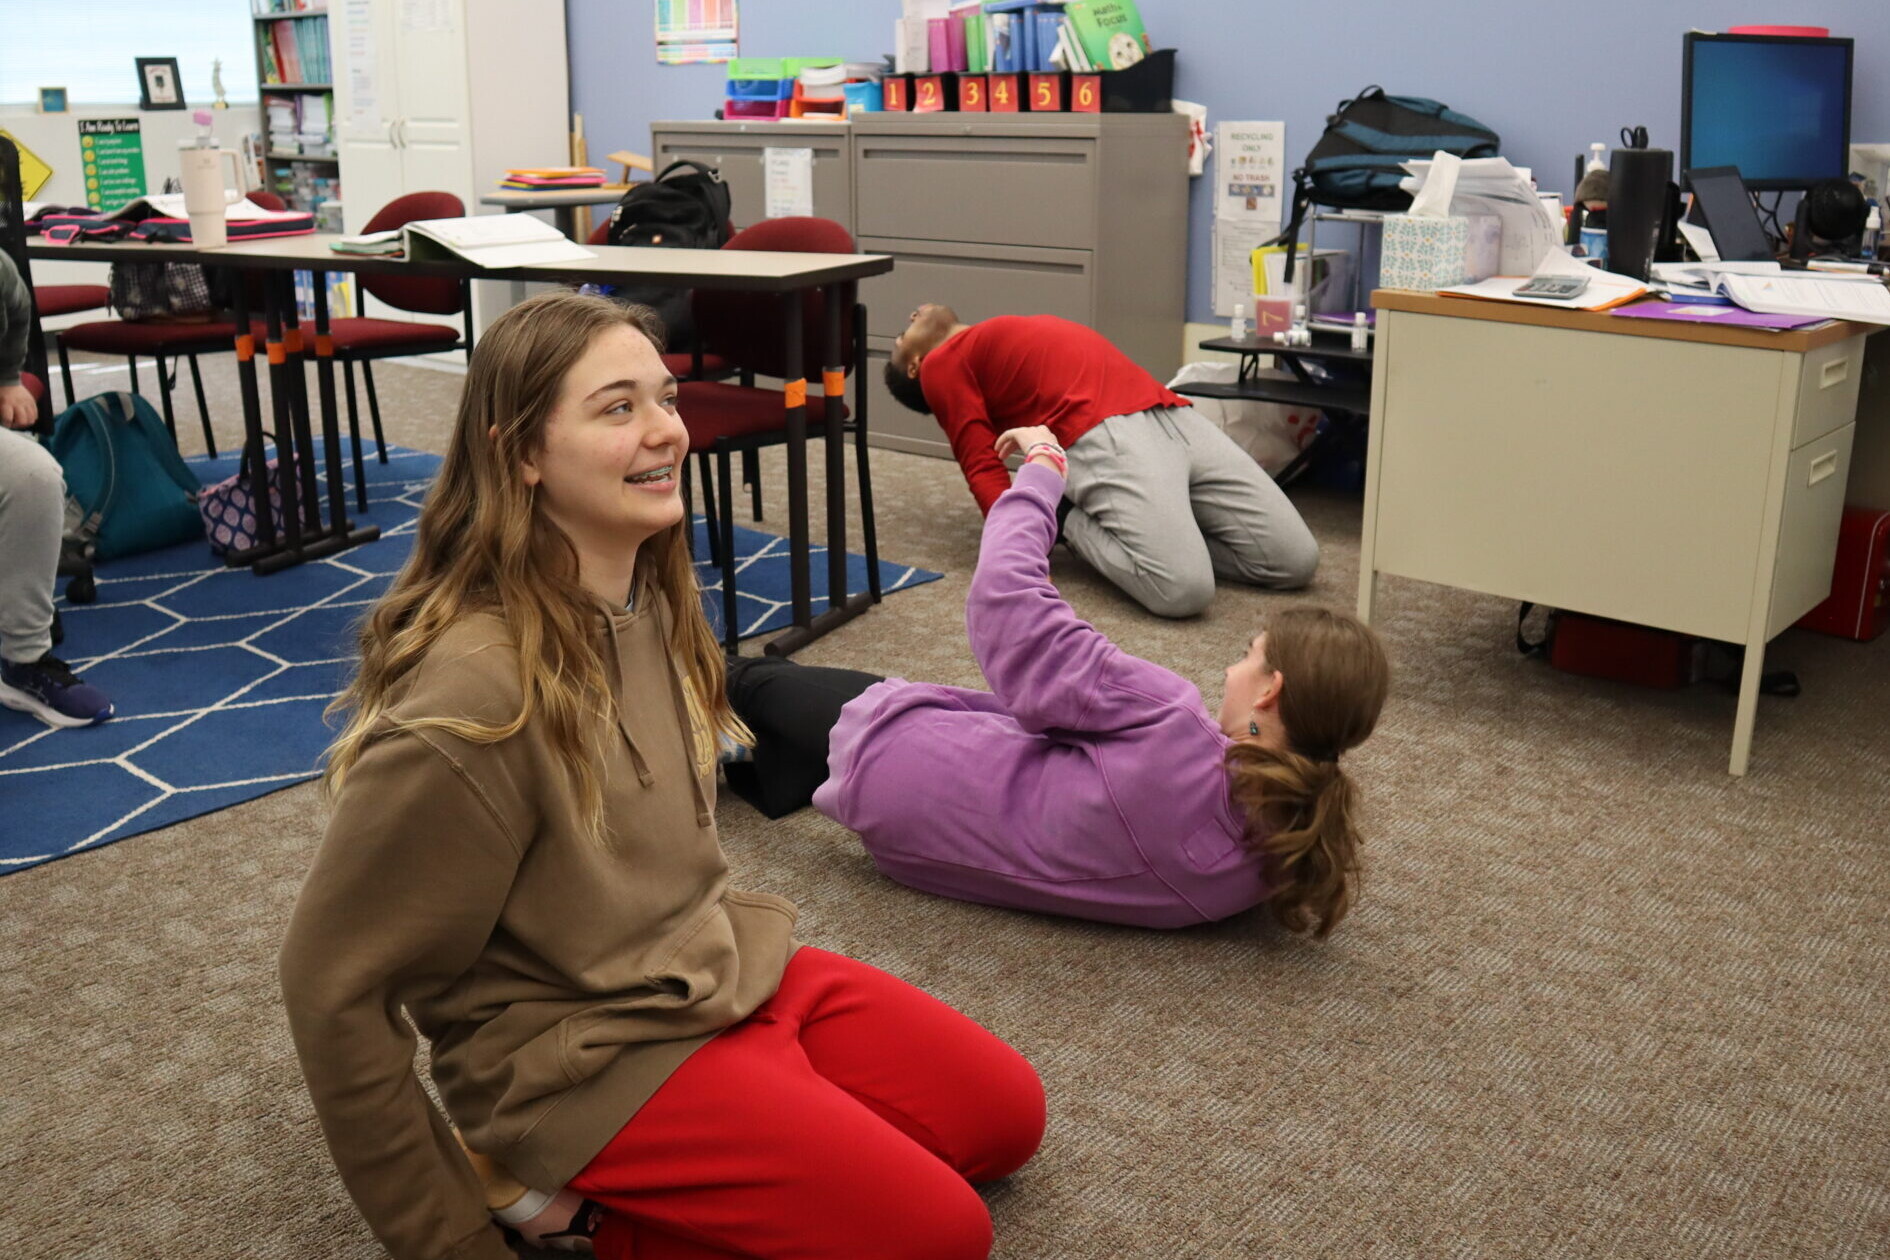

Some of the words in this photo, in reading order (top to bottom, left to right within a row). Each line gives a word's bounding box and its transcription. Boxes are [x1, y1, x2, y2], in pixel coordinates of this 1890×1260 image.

[1096, 13, 1128, 28] Focus
[889, 83, 897, 105] 1
[922, 82, 936, 105] 2
[966, 81, 979, 105] 3
[994, 80, 1009, 104] 4
[1037, 82, 1051, 106] 5
[1079, 81, 1092, 106] 6
[97, 120, 114, 135] Ready
[123, 121, 139, 132] Learn
[1231, 132, 1274, 141] RECYCLING
[1242, 143, 1261, 152] ONLY
[1233, 173, 1244, 181] NO
[1245, 173, 1271, 182] TRASH
